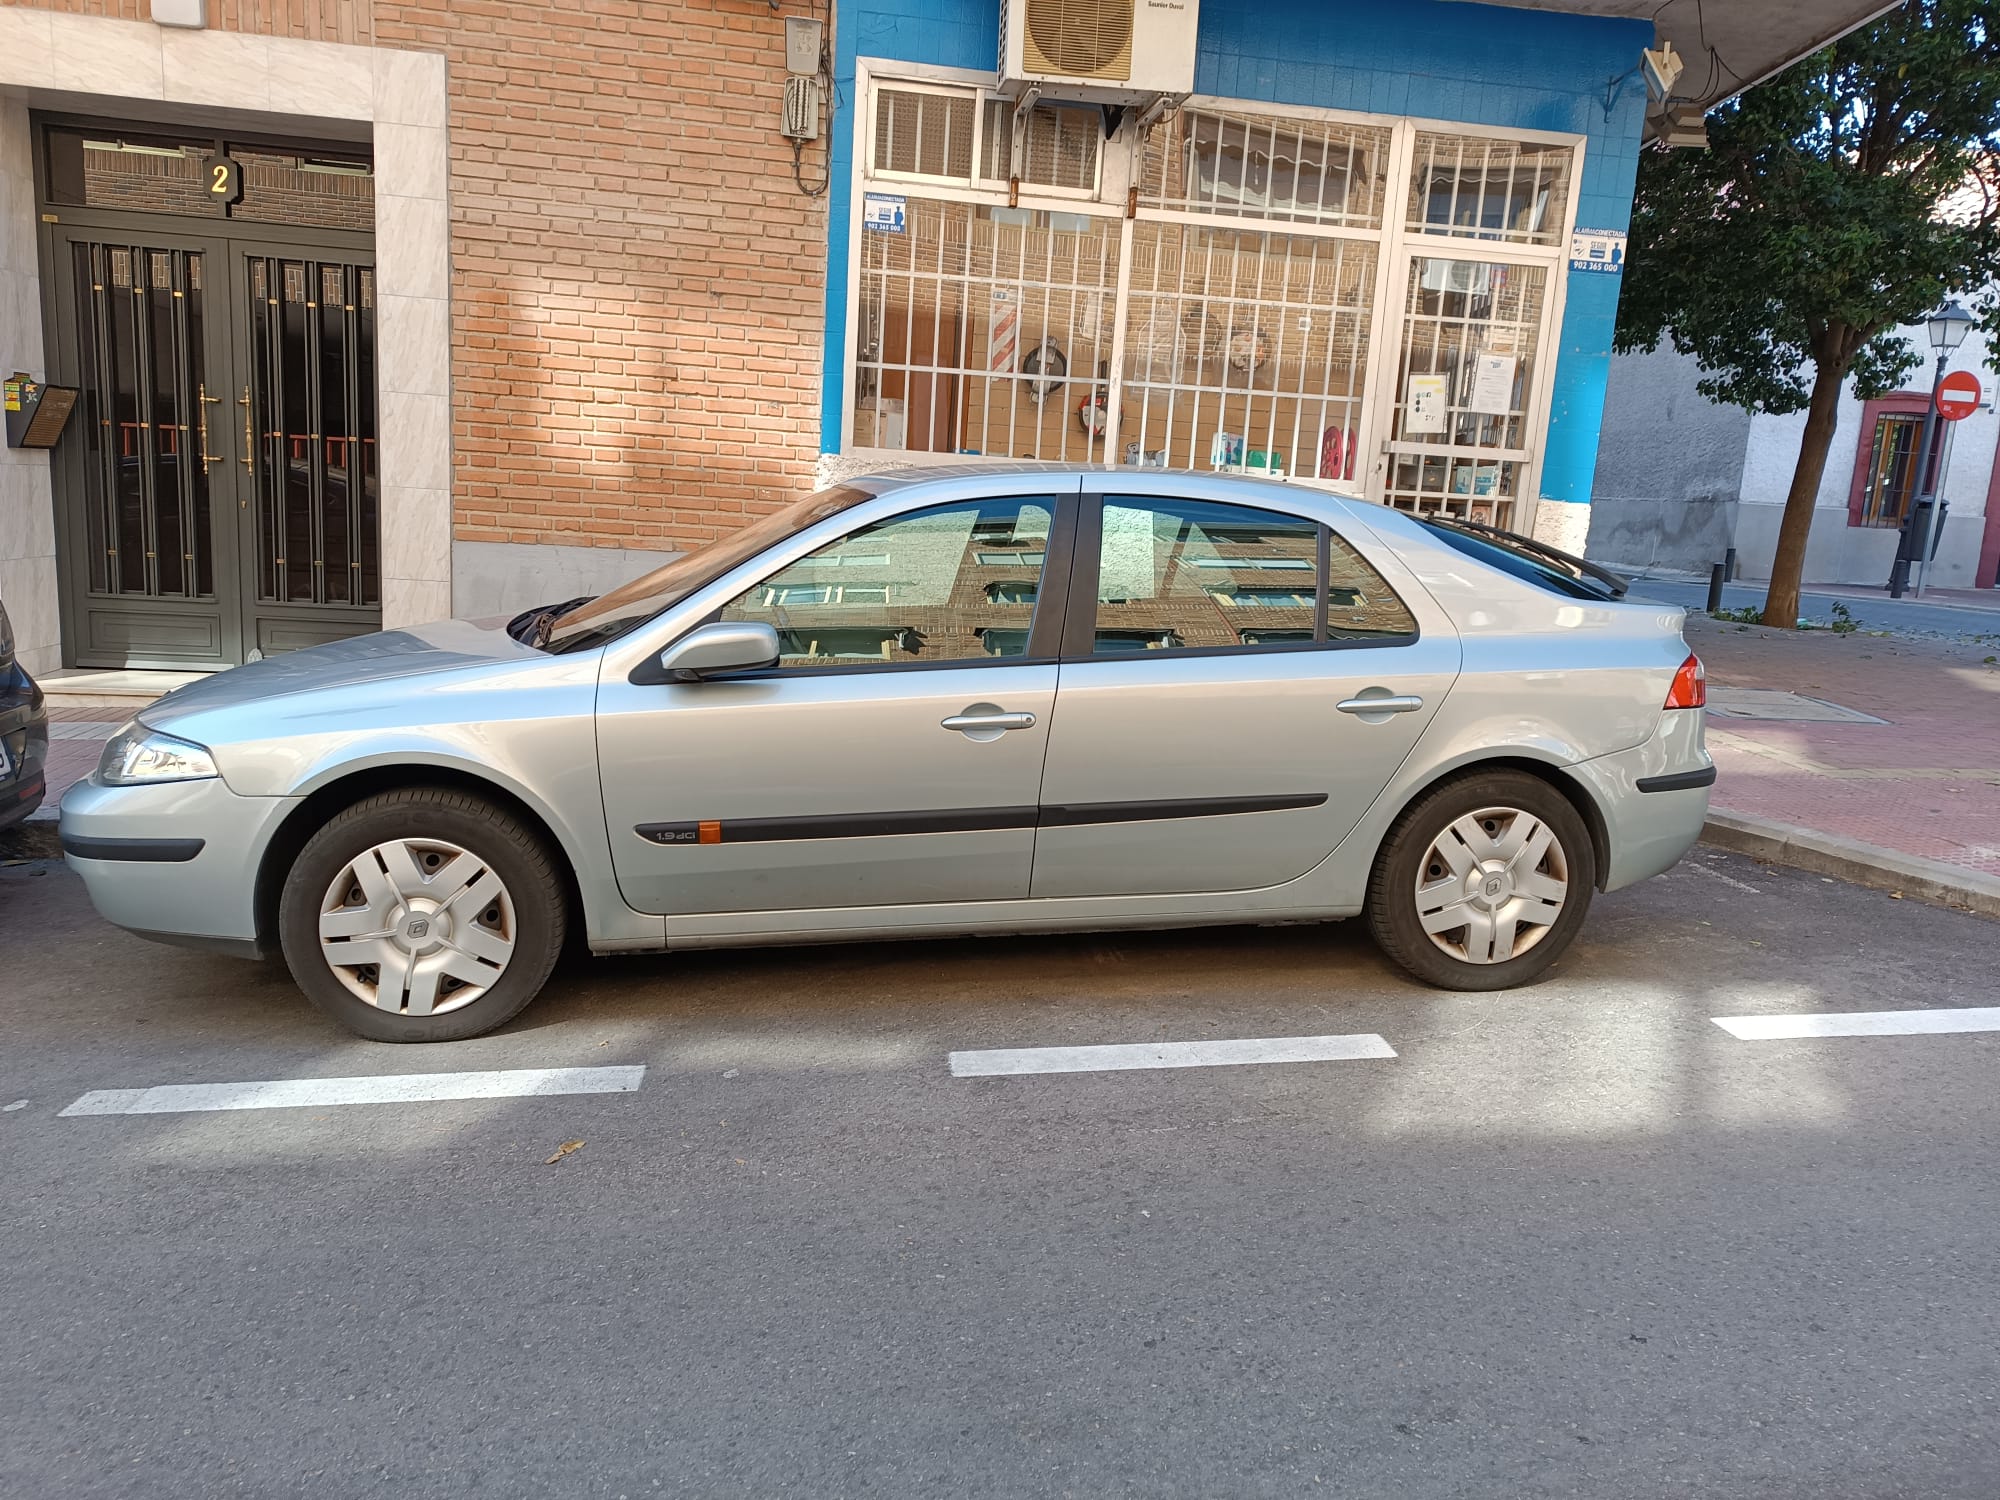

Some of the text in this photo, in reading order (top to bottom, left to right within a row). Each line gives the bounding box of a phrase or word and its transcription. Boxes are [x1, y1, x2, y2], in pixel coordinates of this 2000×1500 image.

[211, 165, 229, 193] 2
[1573, 260, 1618, 272] 902 365 000
